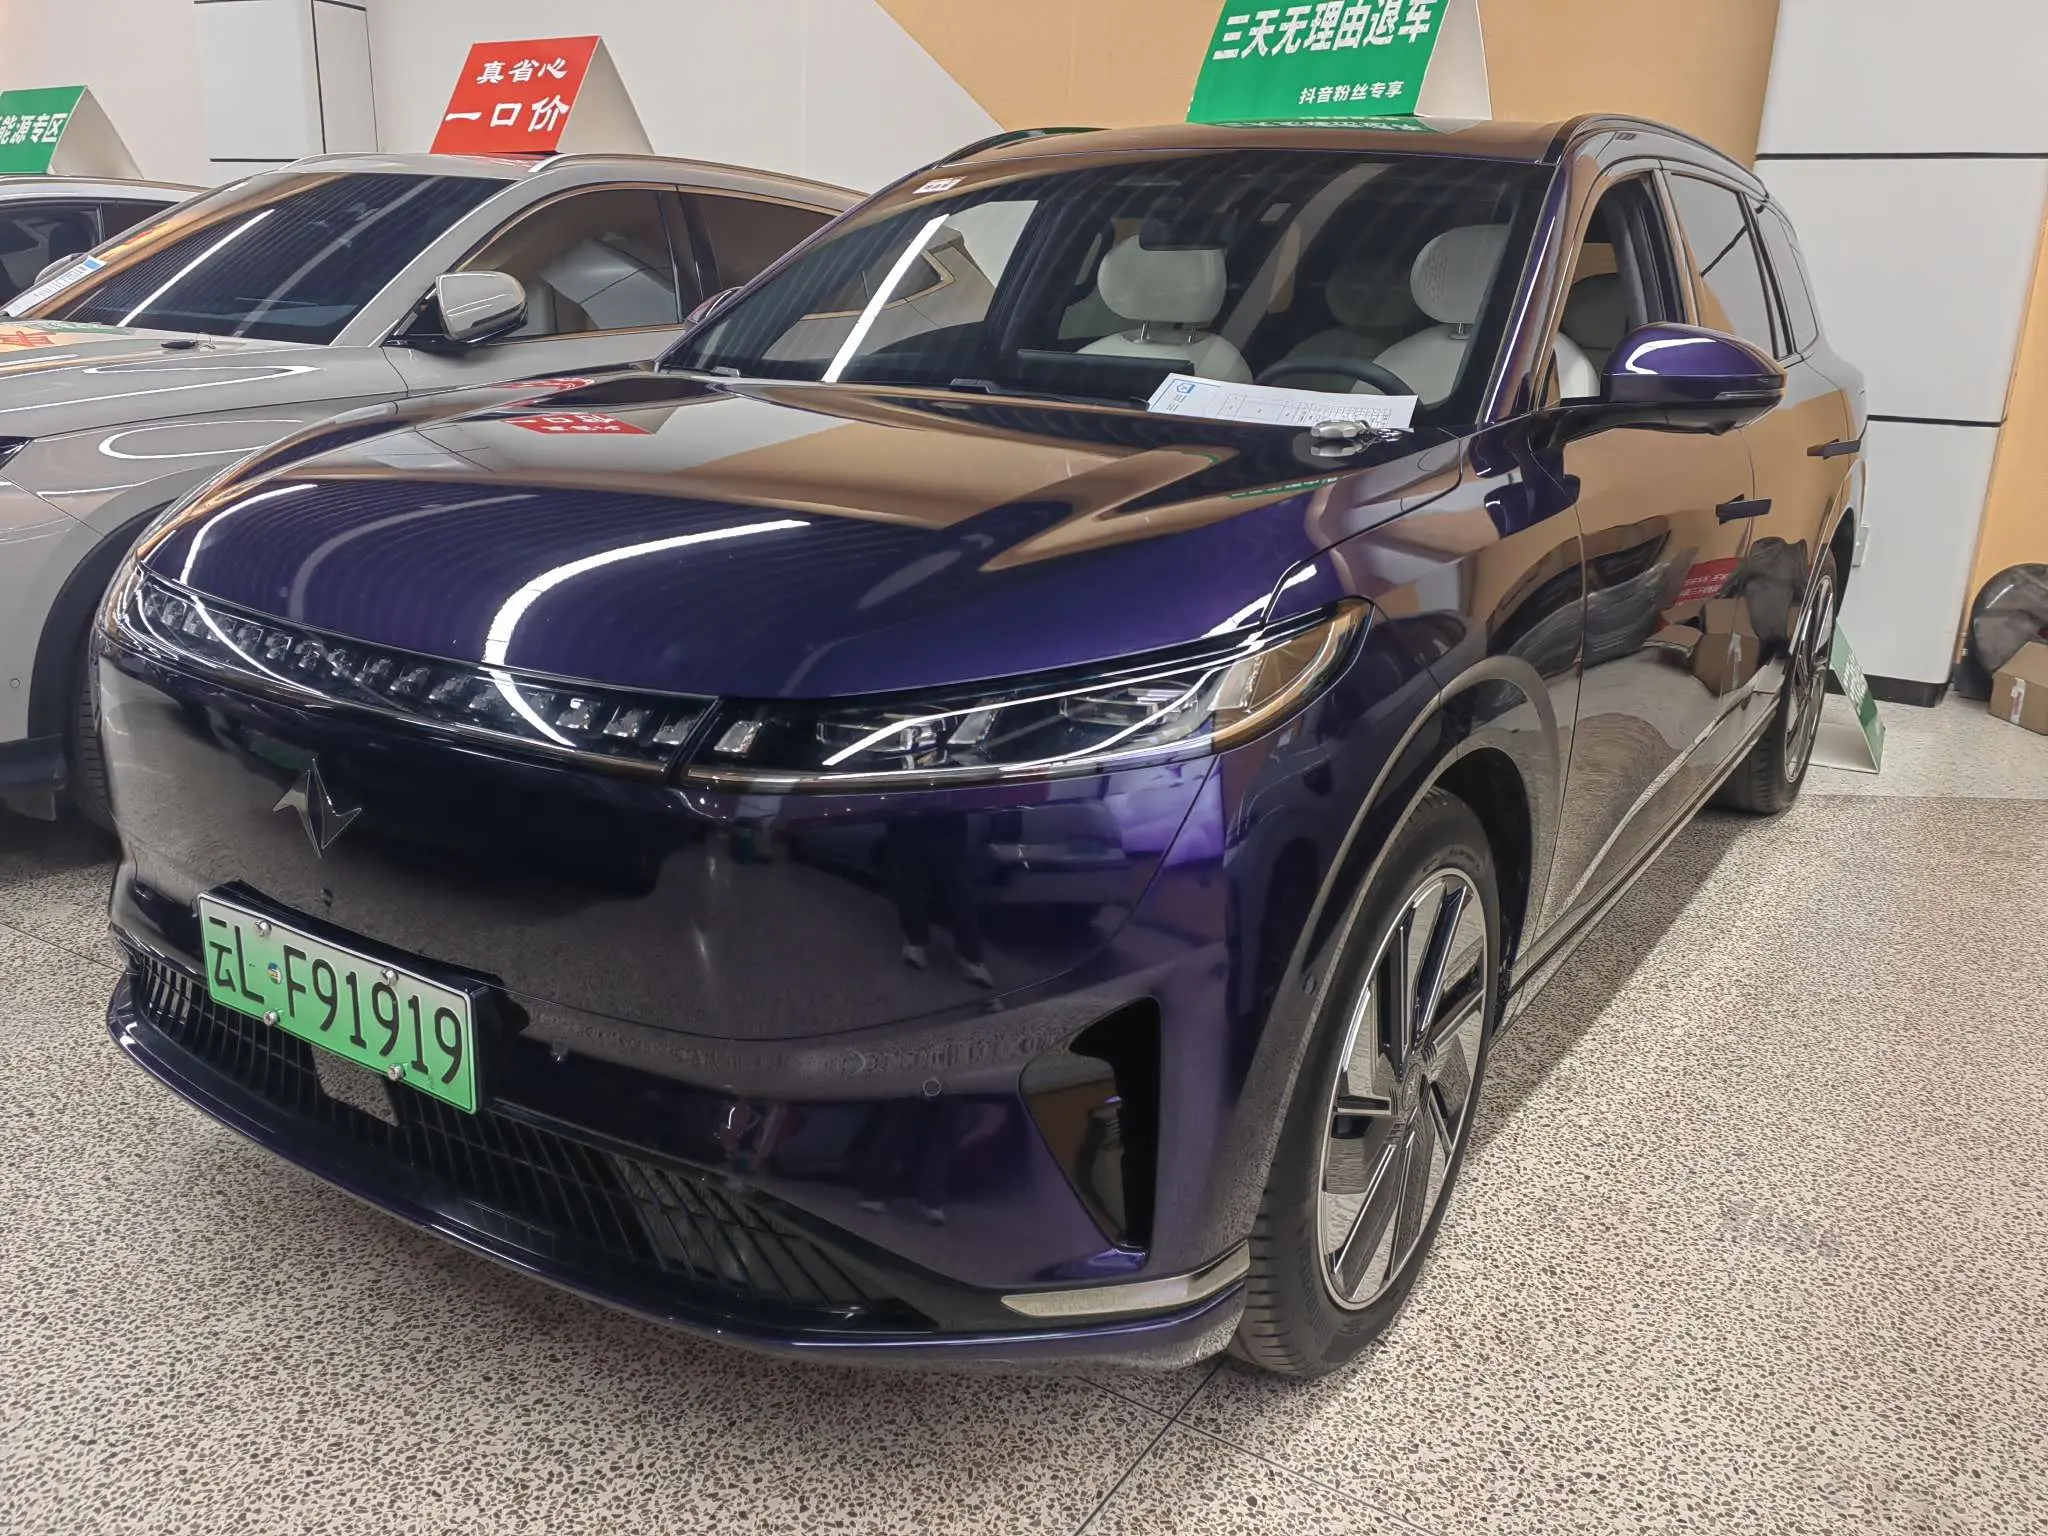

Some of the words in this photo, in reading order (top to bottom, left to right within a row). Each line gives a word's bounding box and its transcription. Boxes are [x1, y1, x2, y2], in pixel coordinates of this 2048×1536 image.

[1213, 0, 1437, 60] 三天无理由退车
[476, 57, 567, 84] 真省心
[1298, 80, 1404, 104] 抖音粉丝专享
[0, 113, 68, 144] 能源专区
[445, 95, 570, 132] 一口价
